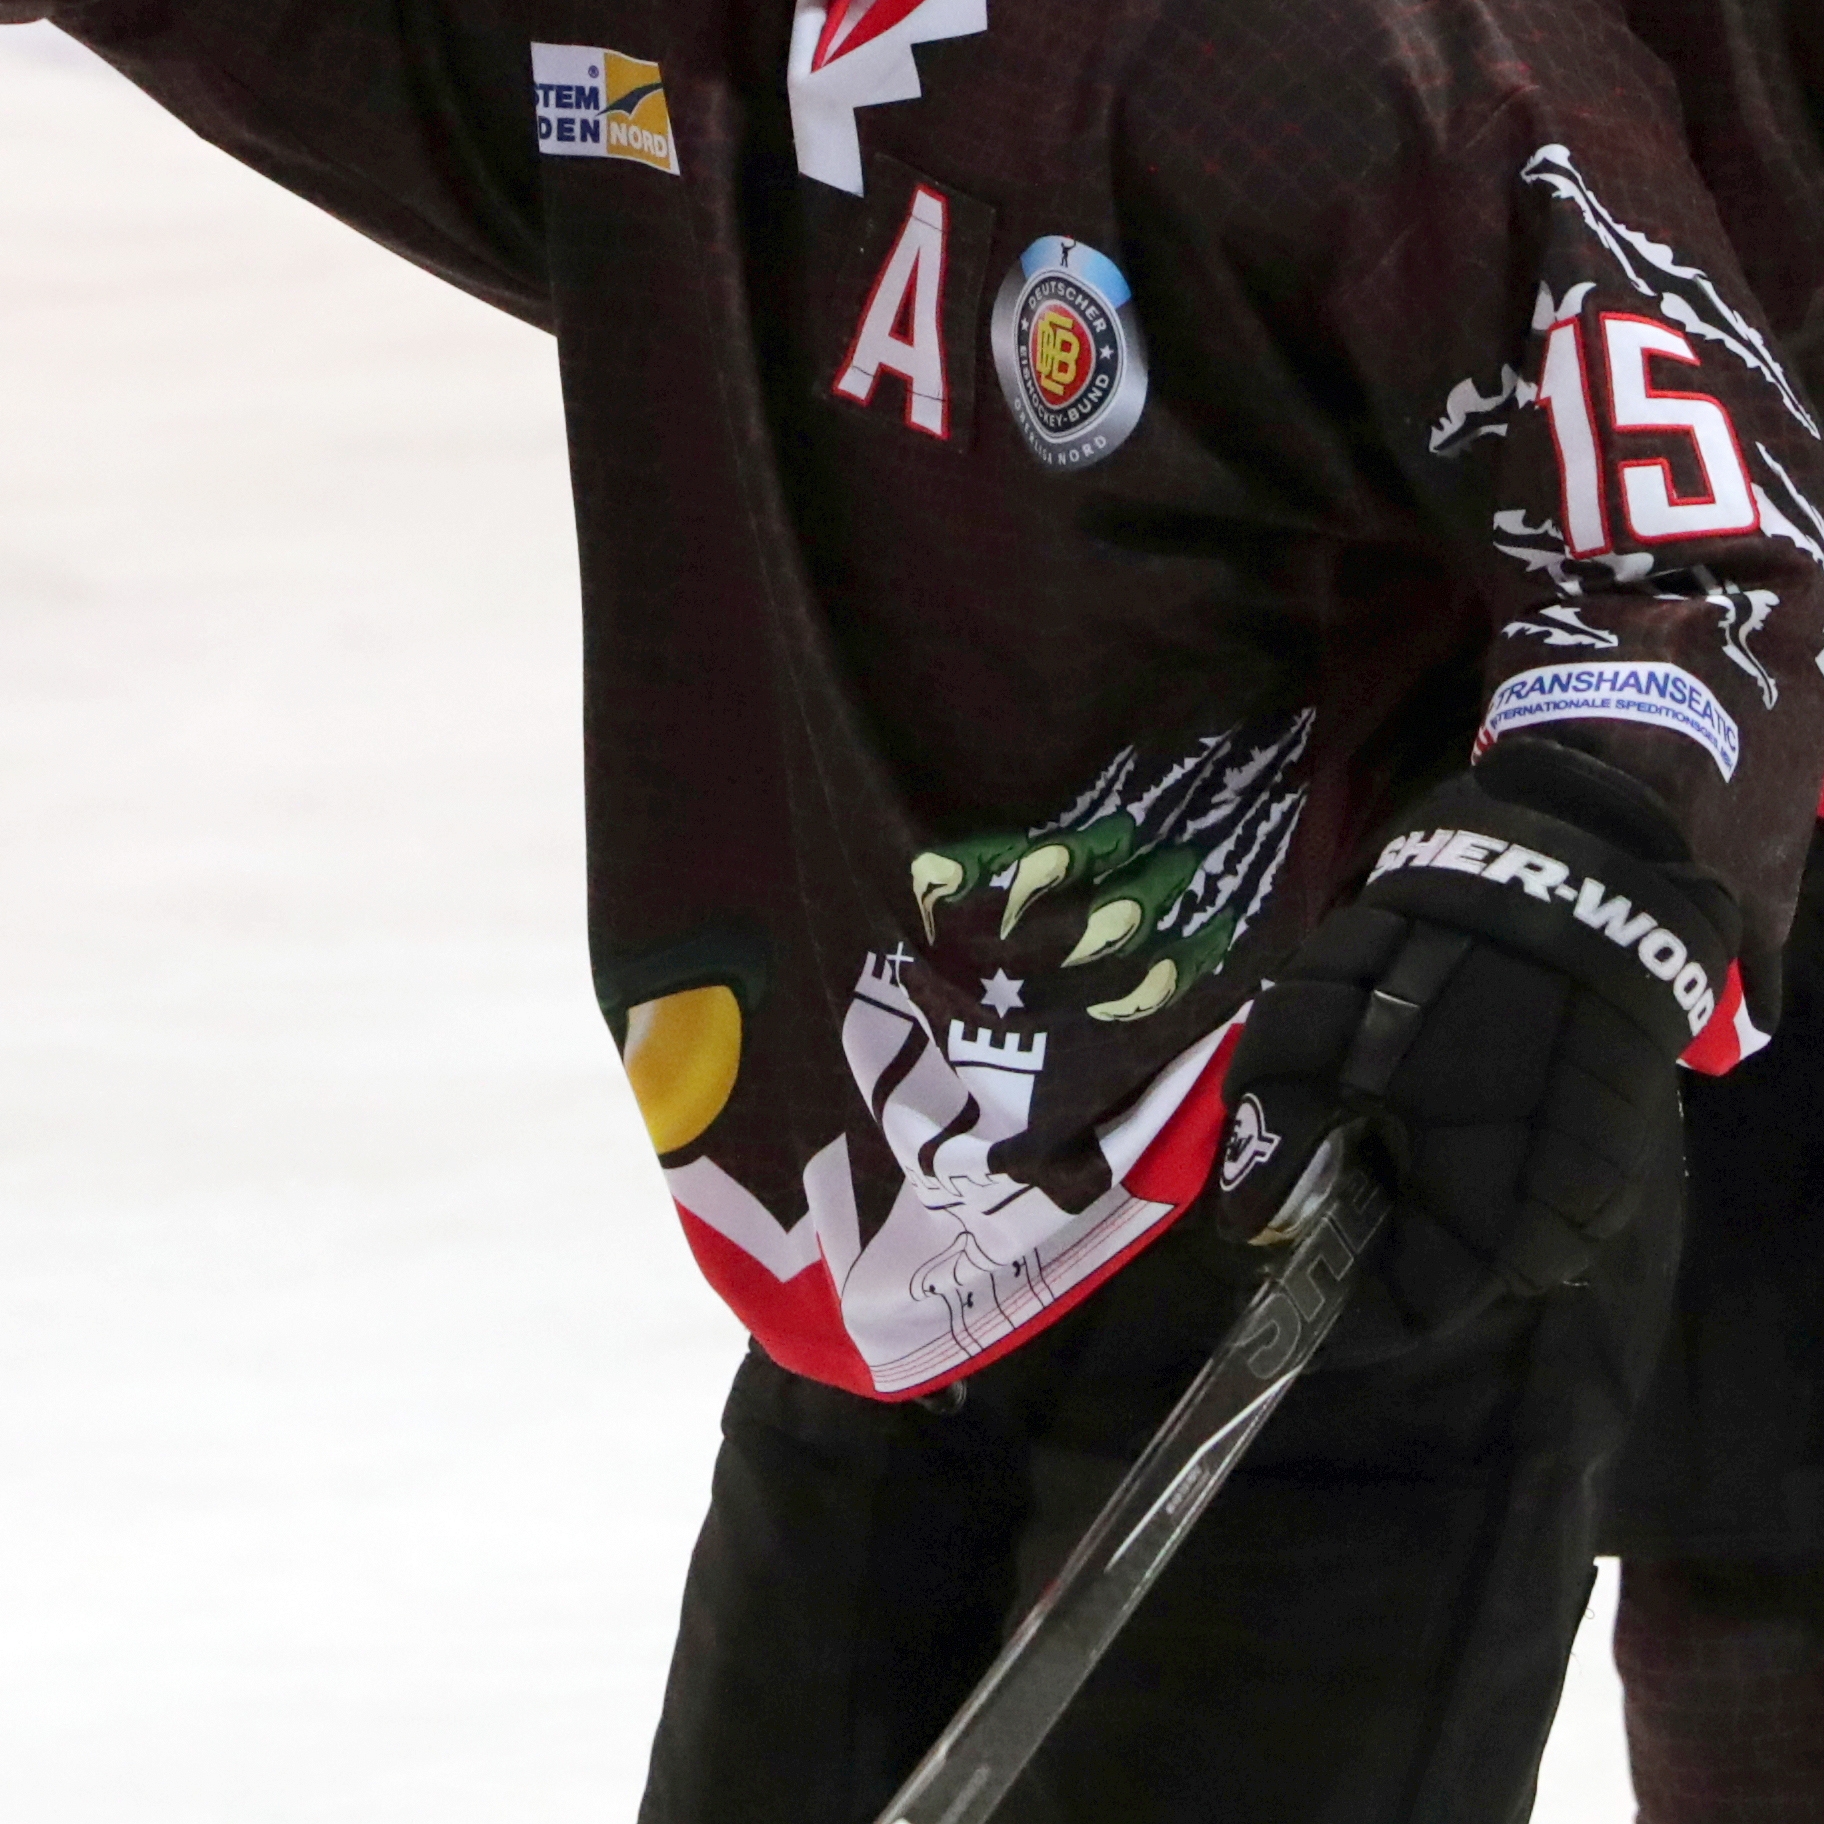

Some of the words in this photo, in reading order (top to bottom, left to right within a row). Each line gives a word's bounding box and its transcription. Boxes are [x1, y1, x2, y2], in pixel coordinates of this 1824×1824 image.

[609, 122, 669, 158] NORD
[832, 183, 950, 440] A
[1028, 280, 1108, 334] DEUTSCHER
[1057, 434, 1108, 466] NORD
[1537, 310, 1761, 559] 15
[1496, 670, 1737, 753] TRANSHANSEATIC
[1366, 829, 1716, 1037] SHER-WOOD
